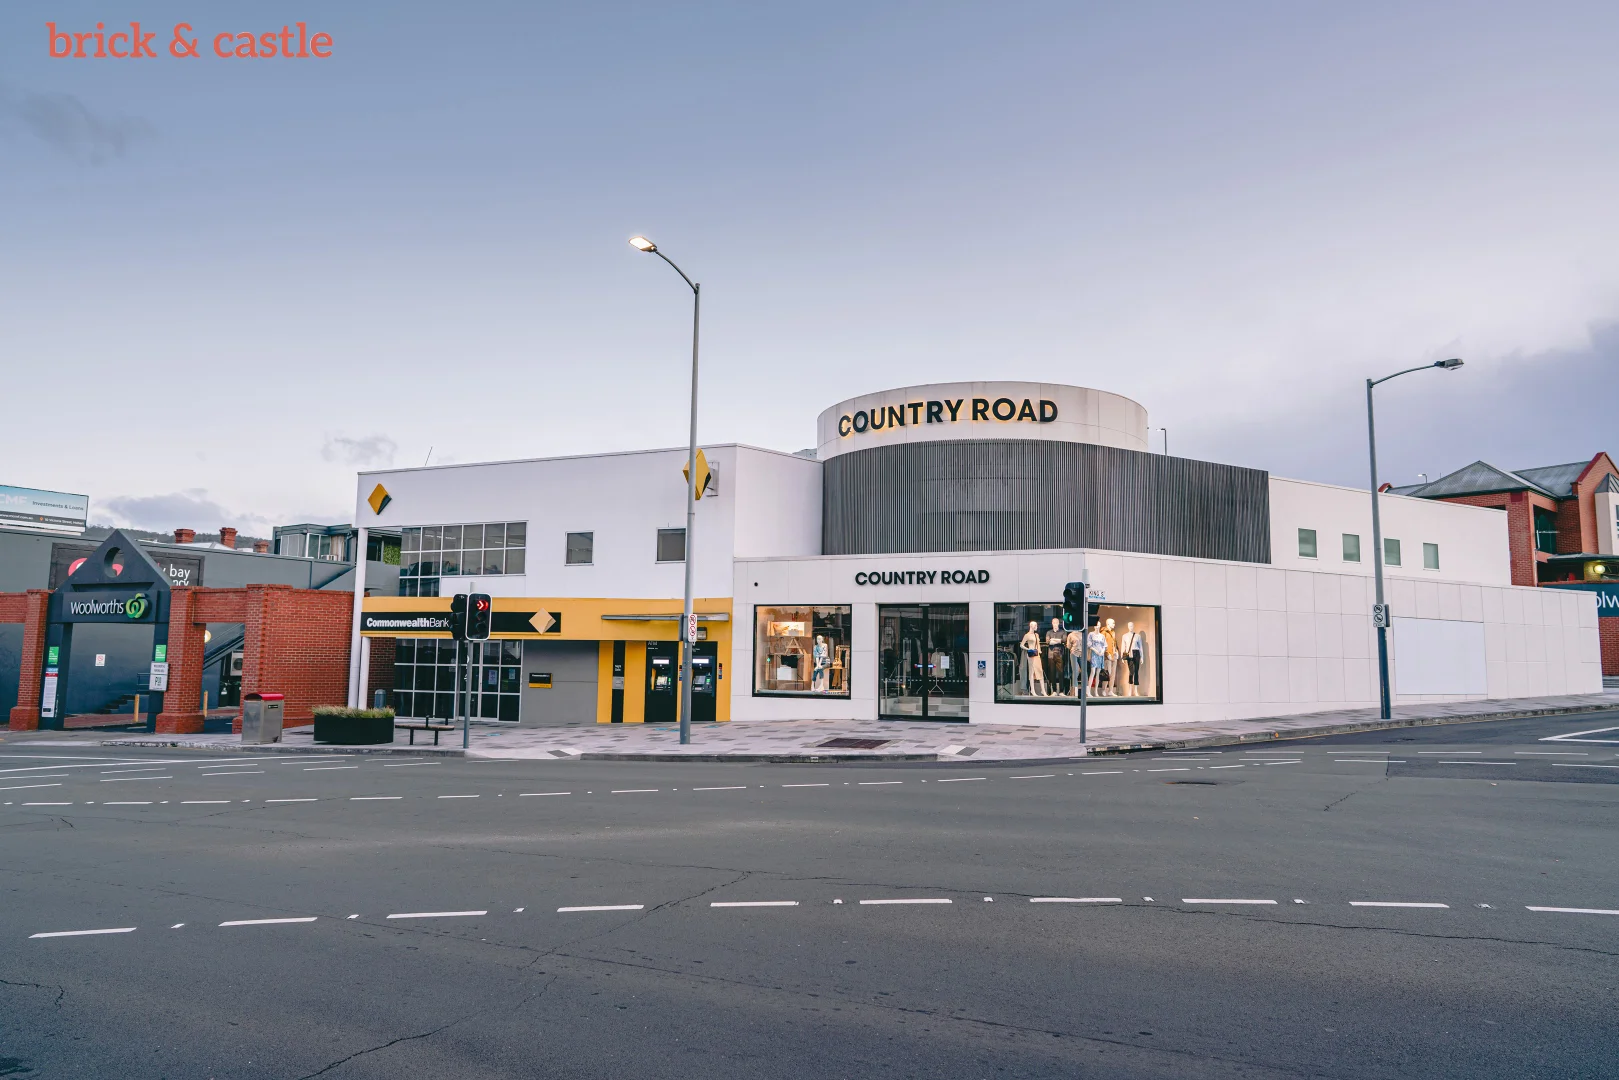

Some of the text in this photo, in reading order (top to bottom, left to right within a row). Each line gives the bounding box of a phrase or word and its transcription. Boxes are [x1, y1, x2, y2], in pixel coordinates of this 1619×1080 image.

[838, 398, 1058, 437] COUNTRY ROAD
[32, 500, 63, 509] Investments
[169, 563, 191, 581] bay
[855, 570, 990, 585] COUNTRY ROAD
[70, 599, 124, 615] Woolworths
[366, 617, 450, 628] CommonwealthBank
